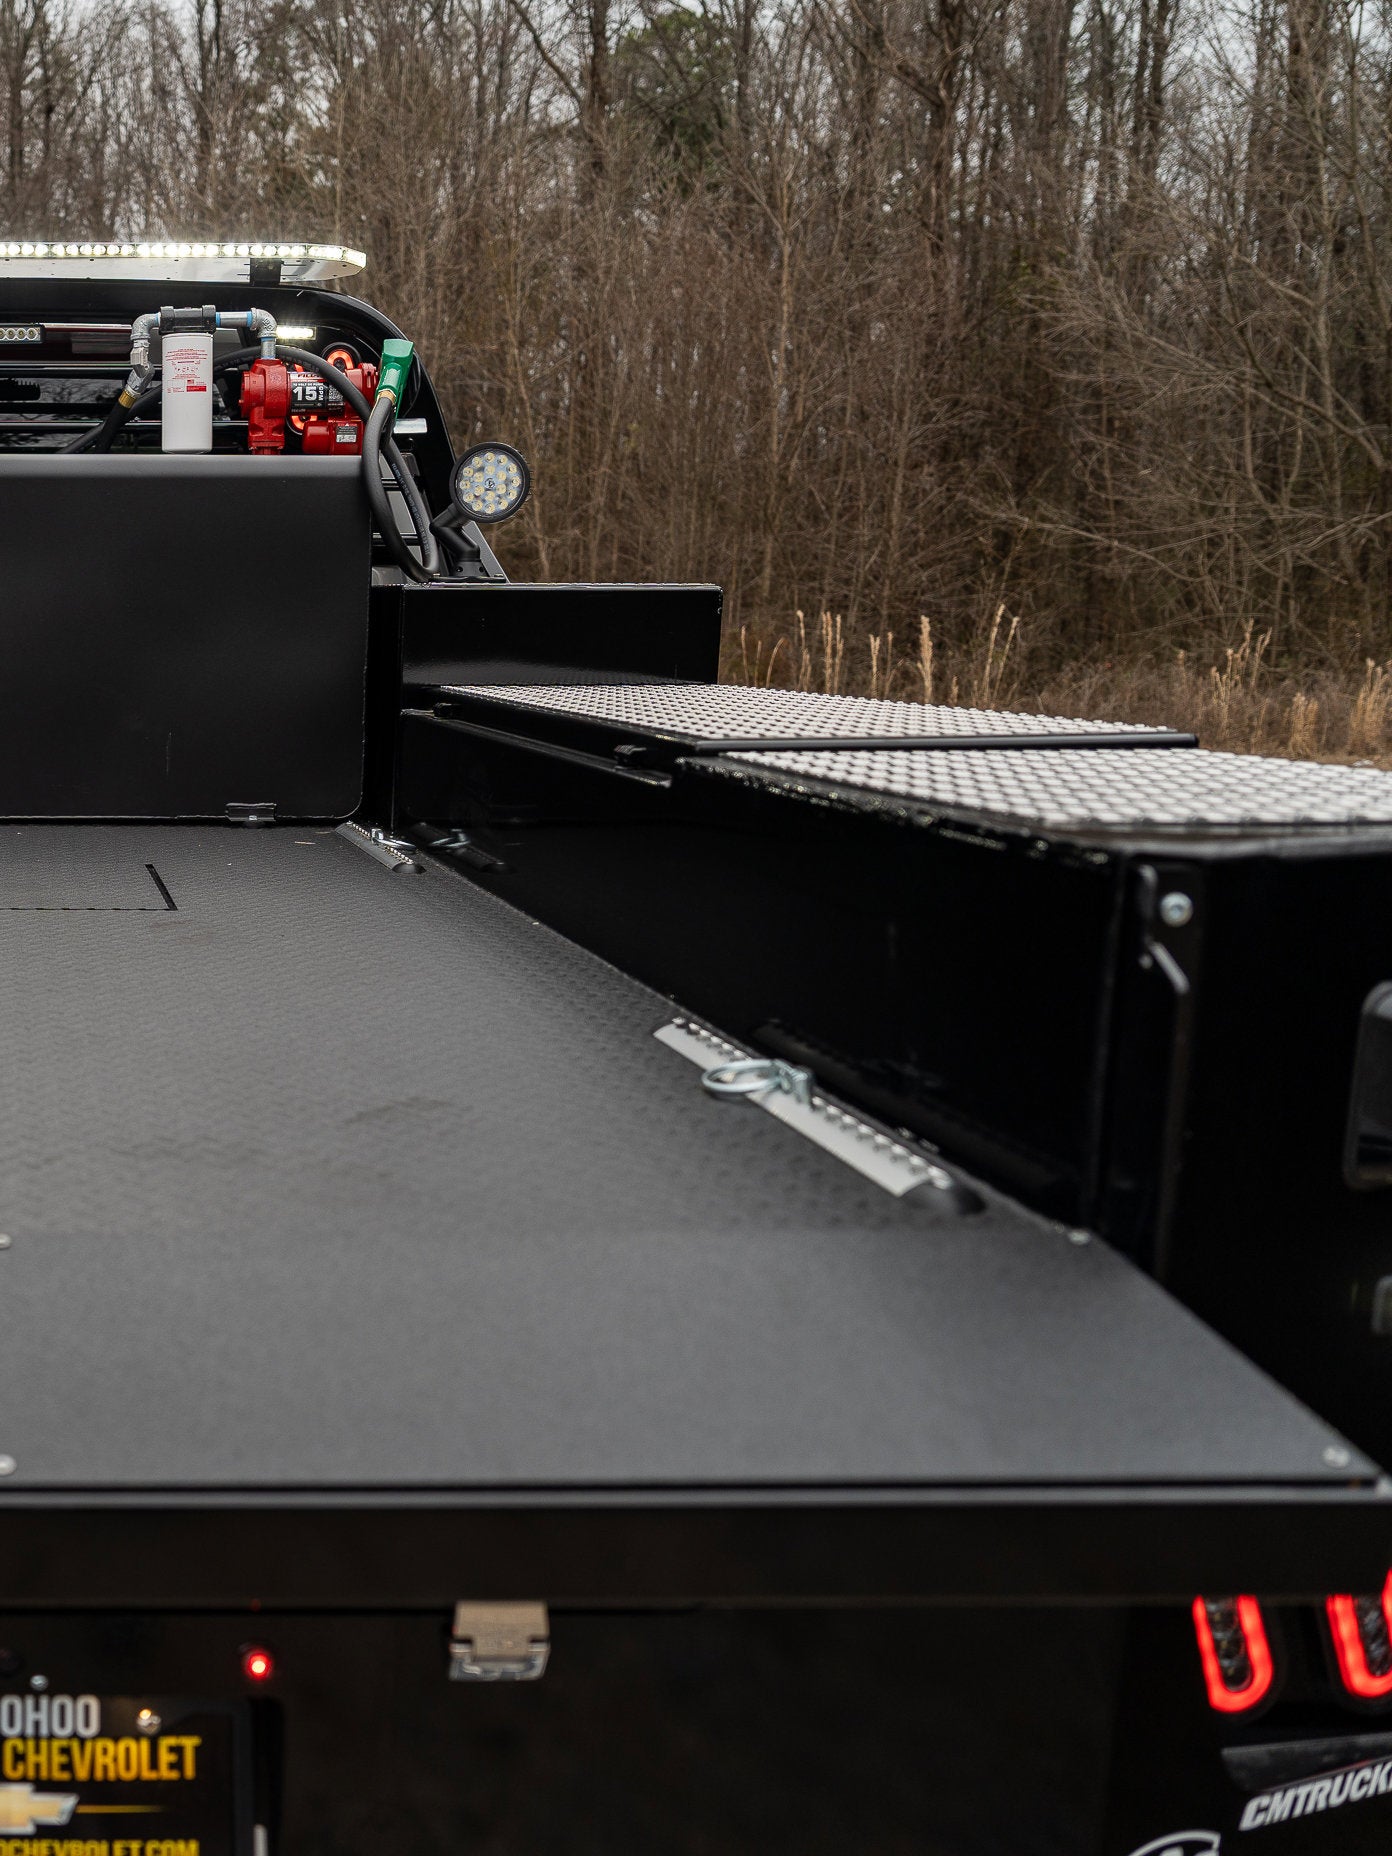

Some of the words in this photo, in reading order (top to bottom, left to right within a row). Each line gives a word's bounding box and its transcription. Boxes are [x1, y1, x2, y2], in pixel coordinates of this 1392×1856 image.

[292, 386, 317, 401] 15
[2, 1735, 202, 1781] CHEVROLET
[1238, 1761, 1392, 1831] CMTRUCK
